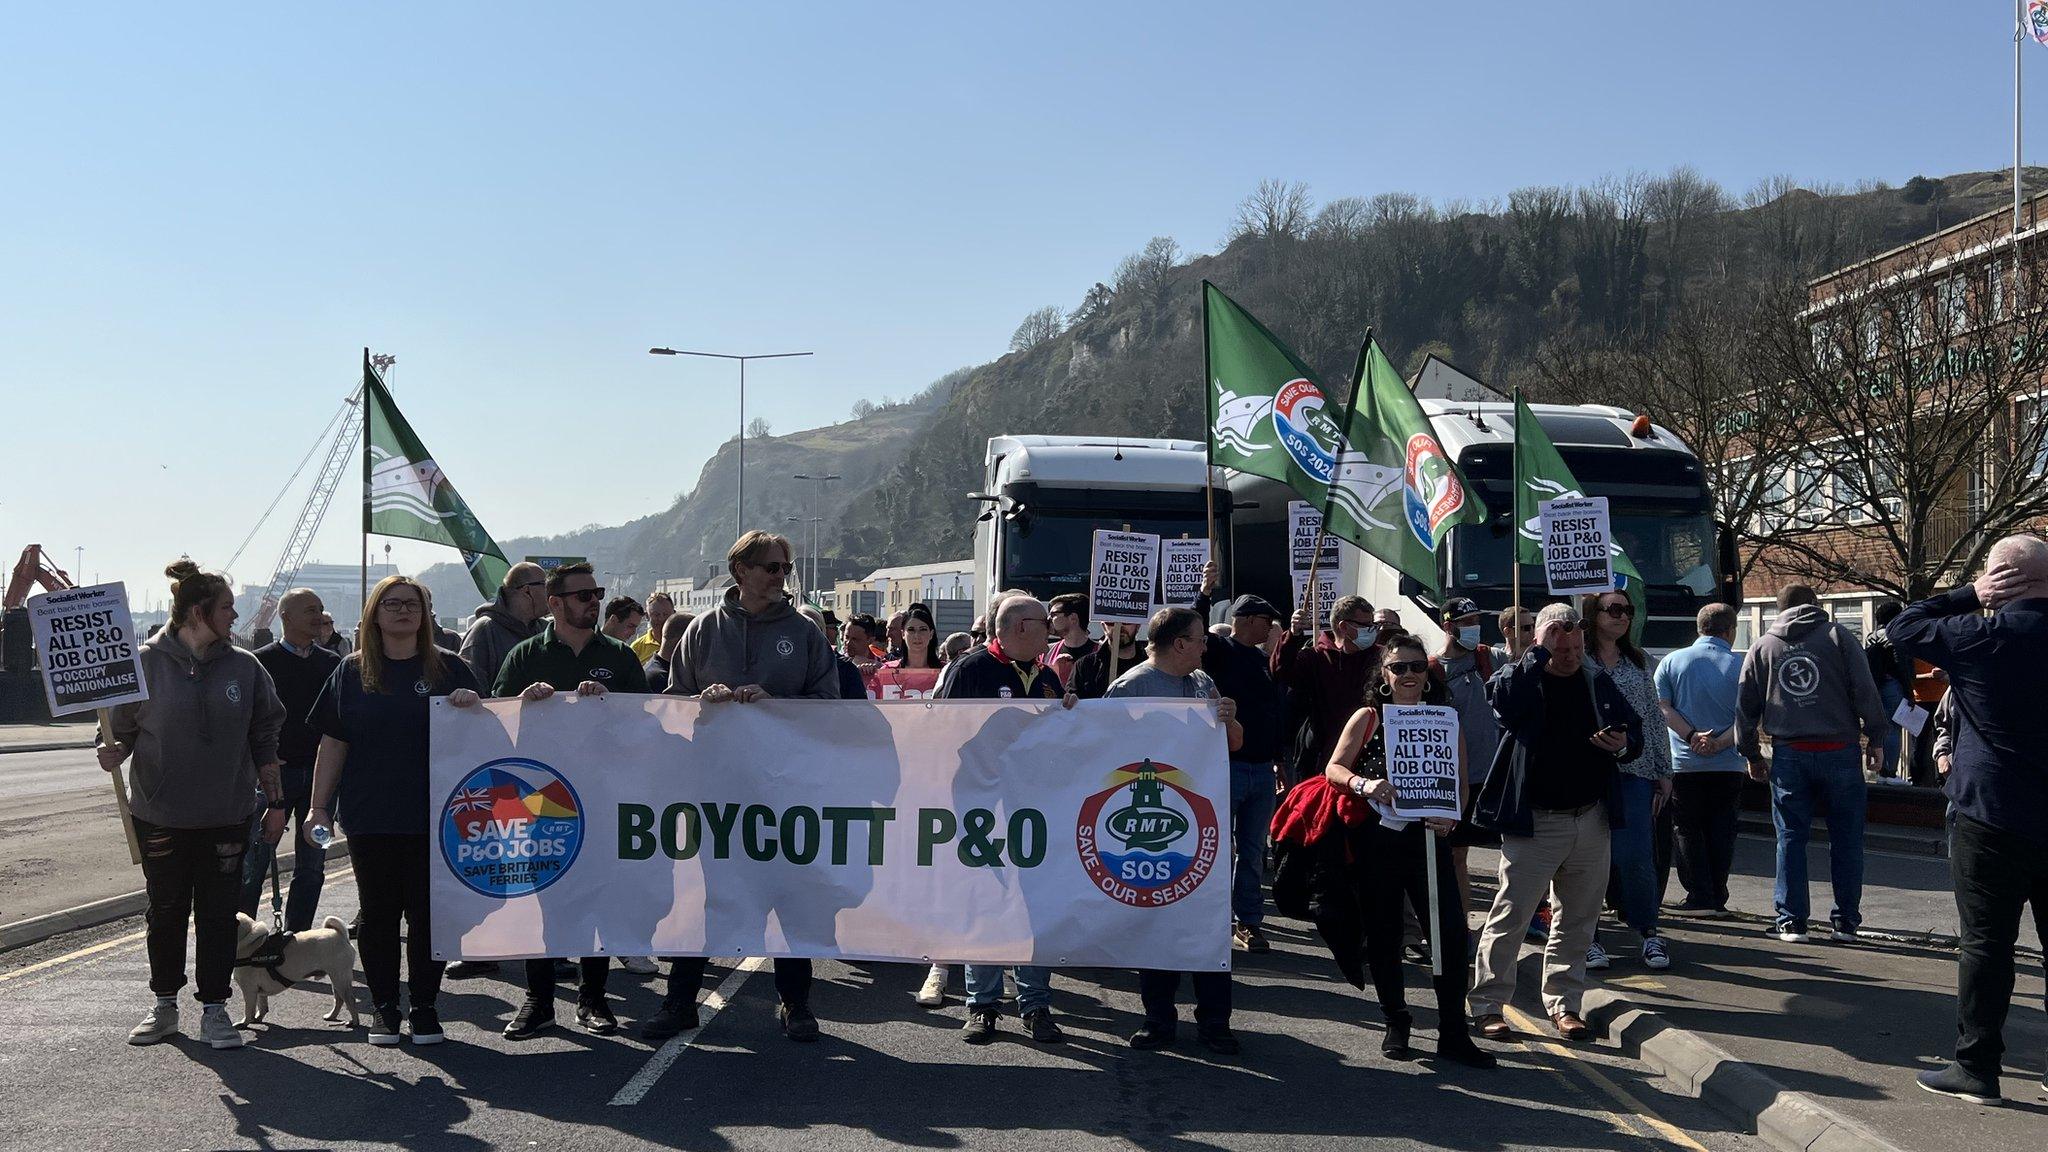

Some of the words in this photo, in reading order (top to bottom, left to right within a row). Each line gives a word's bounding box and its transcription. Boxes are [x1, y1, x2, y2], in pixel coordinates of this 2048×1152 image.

[1280, 386, 1299, 407] SAVE
[1298, 383, 1320, 394] OUR
[1311, 416, 1342, 439] RMT
[1286, 434, 1307, 456] SOS
[1299, 516, 1321, 526] RESI
[1552, 518, 1597, 532] RESIST
[1295, 527, 1313, 537] ALL
[1548, 533, 1571, 546] ALL
[1574, 531, 1602, 544] P&O
[1293, 538, 1311, 547] JOB
[1105, 550, 1147, 564] RESIST
[1171, 554, 1202, 563] RESIST
[1547, 547, 1570, 560] JOB
[1573, 545, 1606, 558] CUTS
[1099, 563, 1121, 575] ALL
[1123, 565, 1149, 577] P&O
[1167, 564, 1183, 573] ALL
[1555, 561, 1588, 571] OCCUPY
[1165, 574, 1182, 583] JOB
[1556, 569, 1607, 581] NATIONALISE
[1096, 575, 1117, 588] JOB
[1120, 577, 1150, 591] CUTS
[1302, 582, 1333, 592] RIST
[46, 593, 78, 605] Socialist
[78, 590, 106, 600] Worker
[1102, 590, 1132, 600] OCCUPY
[58, 604, 76, 614] back
[78, 602, 91, 611] the
[1102, 599, 1148, 611] NATIONALISE
[50, 610, 113, 633] RESIST
[49, 634, 81, 651] ALL
[84, 626, 123, 647] P&O
[48, 651, 82, 670] JOB
[84, 643, 131, 665] CUTS
[63, 665, 107, 682] OCCUPY
[65, 672, 136, 694] NATIONALISE
[1397, 709, 1425, 717] Socialist
[1425, 709, 1446, 717] Worker
[1398, 728, 1449, 743] RESIST
[1394, 745, 1421, 759] ALL
[1424, 744, 1452, 760] P&O
[1392, 760, 1419, 774] JOB
[1422, 761, 1455, 777] CUTS
[1402, 778, 1439, 788] OCCUPY
[1402, 789, 1456, 801] NATIONALISE
[467, 818, 529, 842] SAVE
[549, 825, 570, 833] RMT
[1124, 818, 1173, 833] RMT
[617, 802, 896, 866] BOYCOTT
[917, 807, 1047, 869] P&O
[458, 841, 503, 863] P&O
[507, 838, 566, 859] JOBS
[464, 863, 496, 877] SAVE
[498, 860, 561, 874] BRITAIN'S
[1078, 825, 1099, 870] SAVE
[1101, 877, 1138, 904] OUR
[1151, 825, 1216, 905] SEAFARERS
[1121, 861, 1171, 880] SOS
[489, 872, 538, 886] FERRIES
